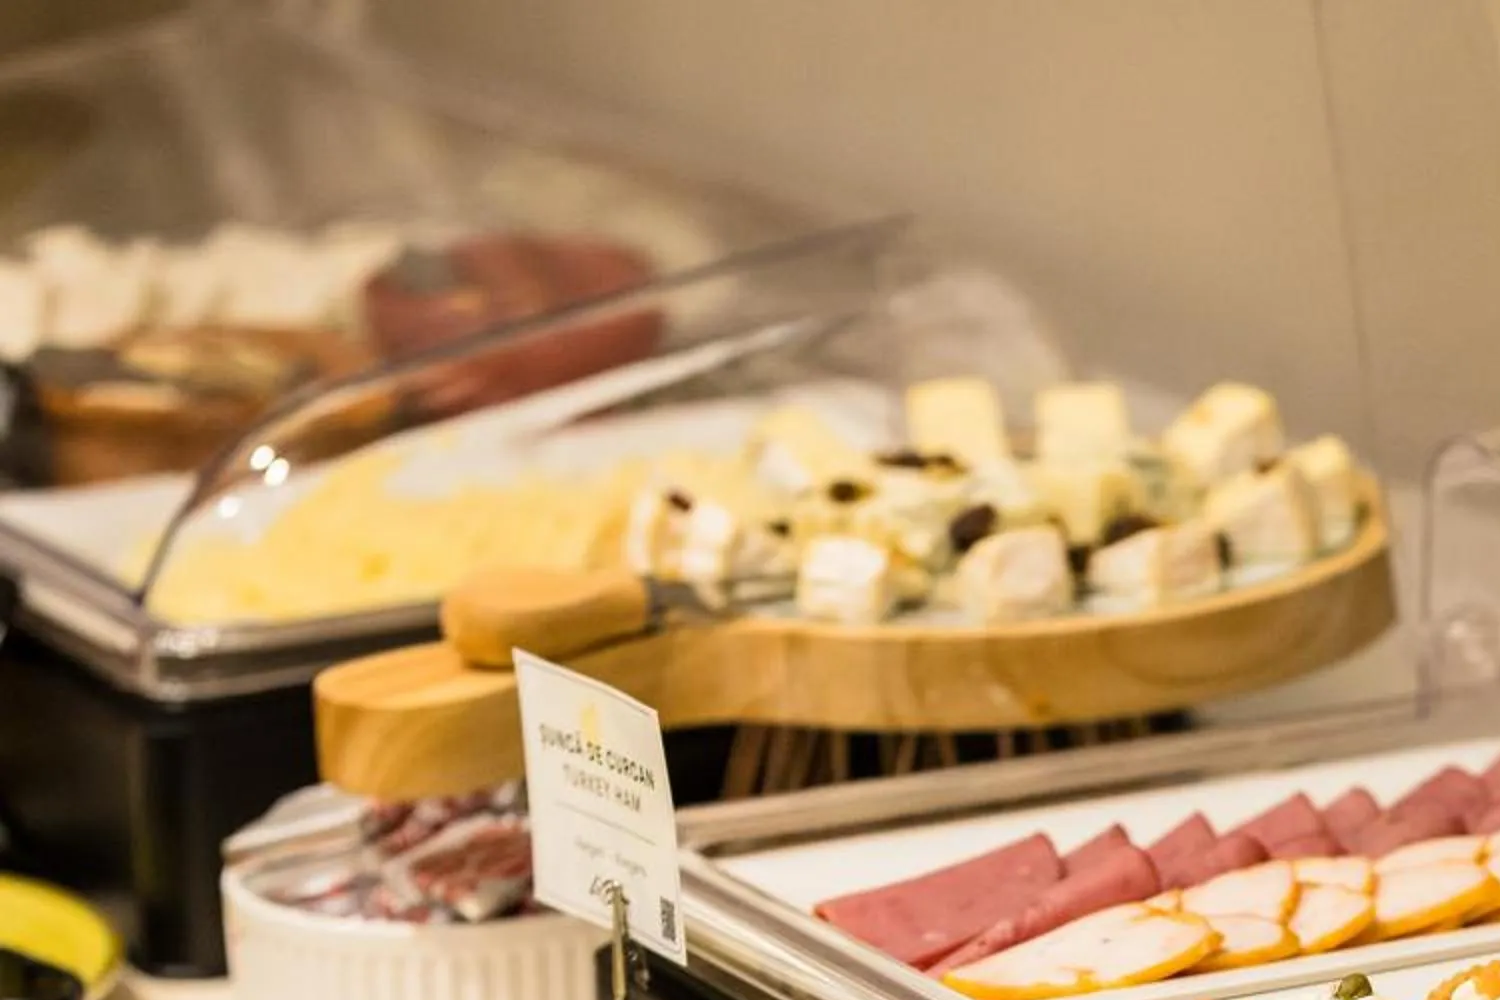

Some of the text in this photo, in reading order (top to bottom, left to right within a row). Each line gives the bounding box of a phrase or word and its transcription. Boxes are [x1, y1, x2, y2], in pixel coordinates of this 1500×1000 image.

[562, 763, 641, 812] TURKEY HAM
[586, 741, 602, 766] DE
[606, 749, 656, 791] CURCAN
